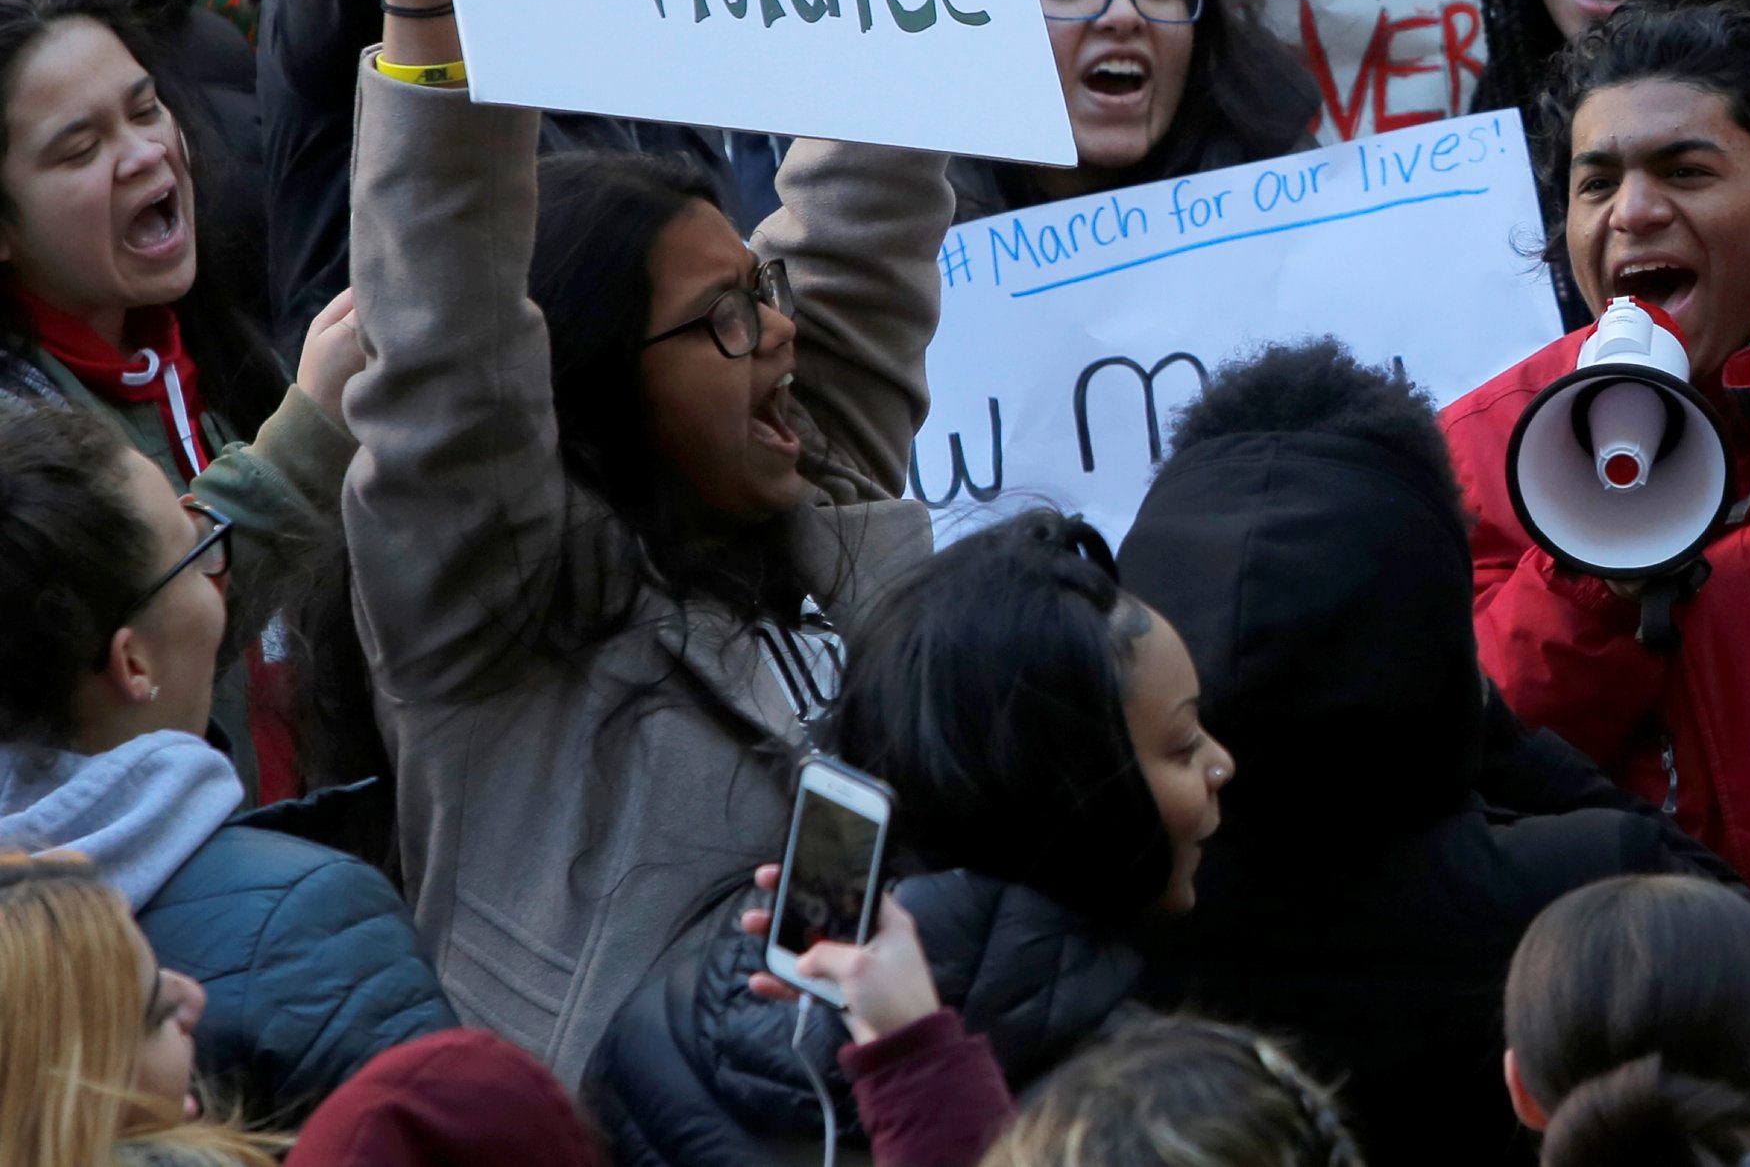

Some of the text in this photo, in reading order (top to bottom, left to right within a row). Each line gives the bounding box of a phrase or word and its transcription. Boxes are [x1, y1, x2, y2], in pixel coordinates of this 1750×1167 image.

[1167, 179, 1232, 236] for
[1253, 160, 1334, 213] our
[1358, 118, 1506, 193] lives!
